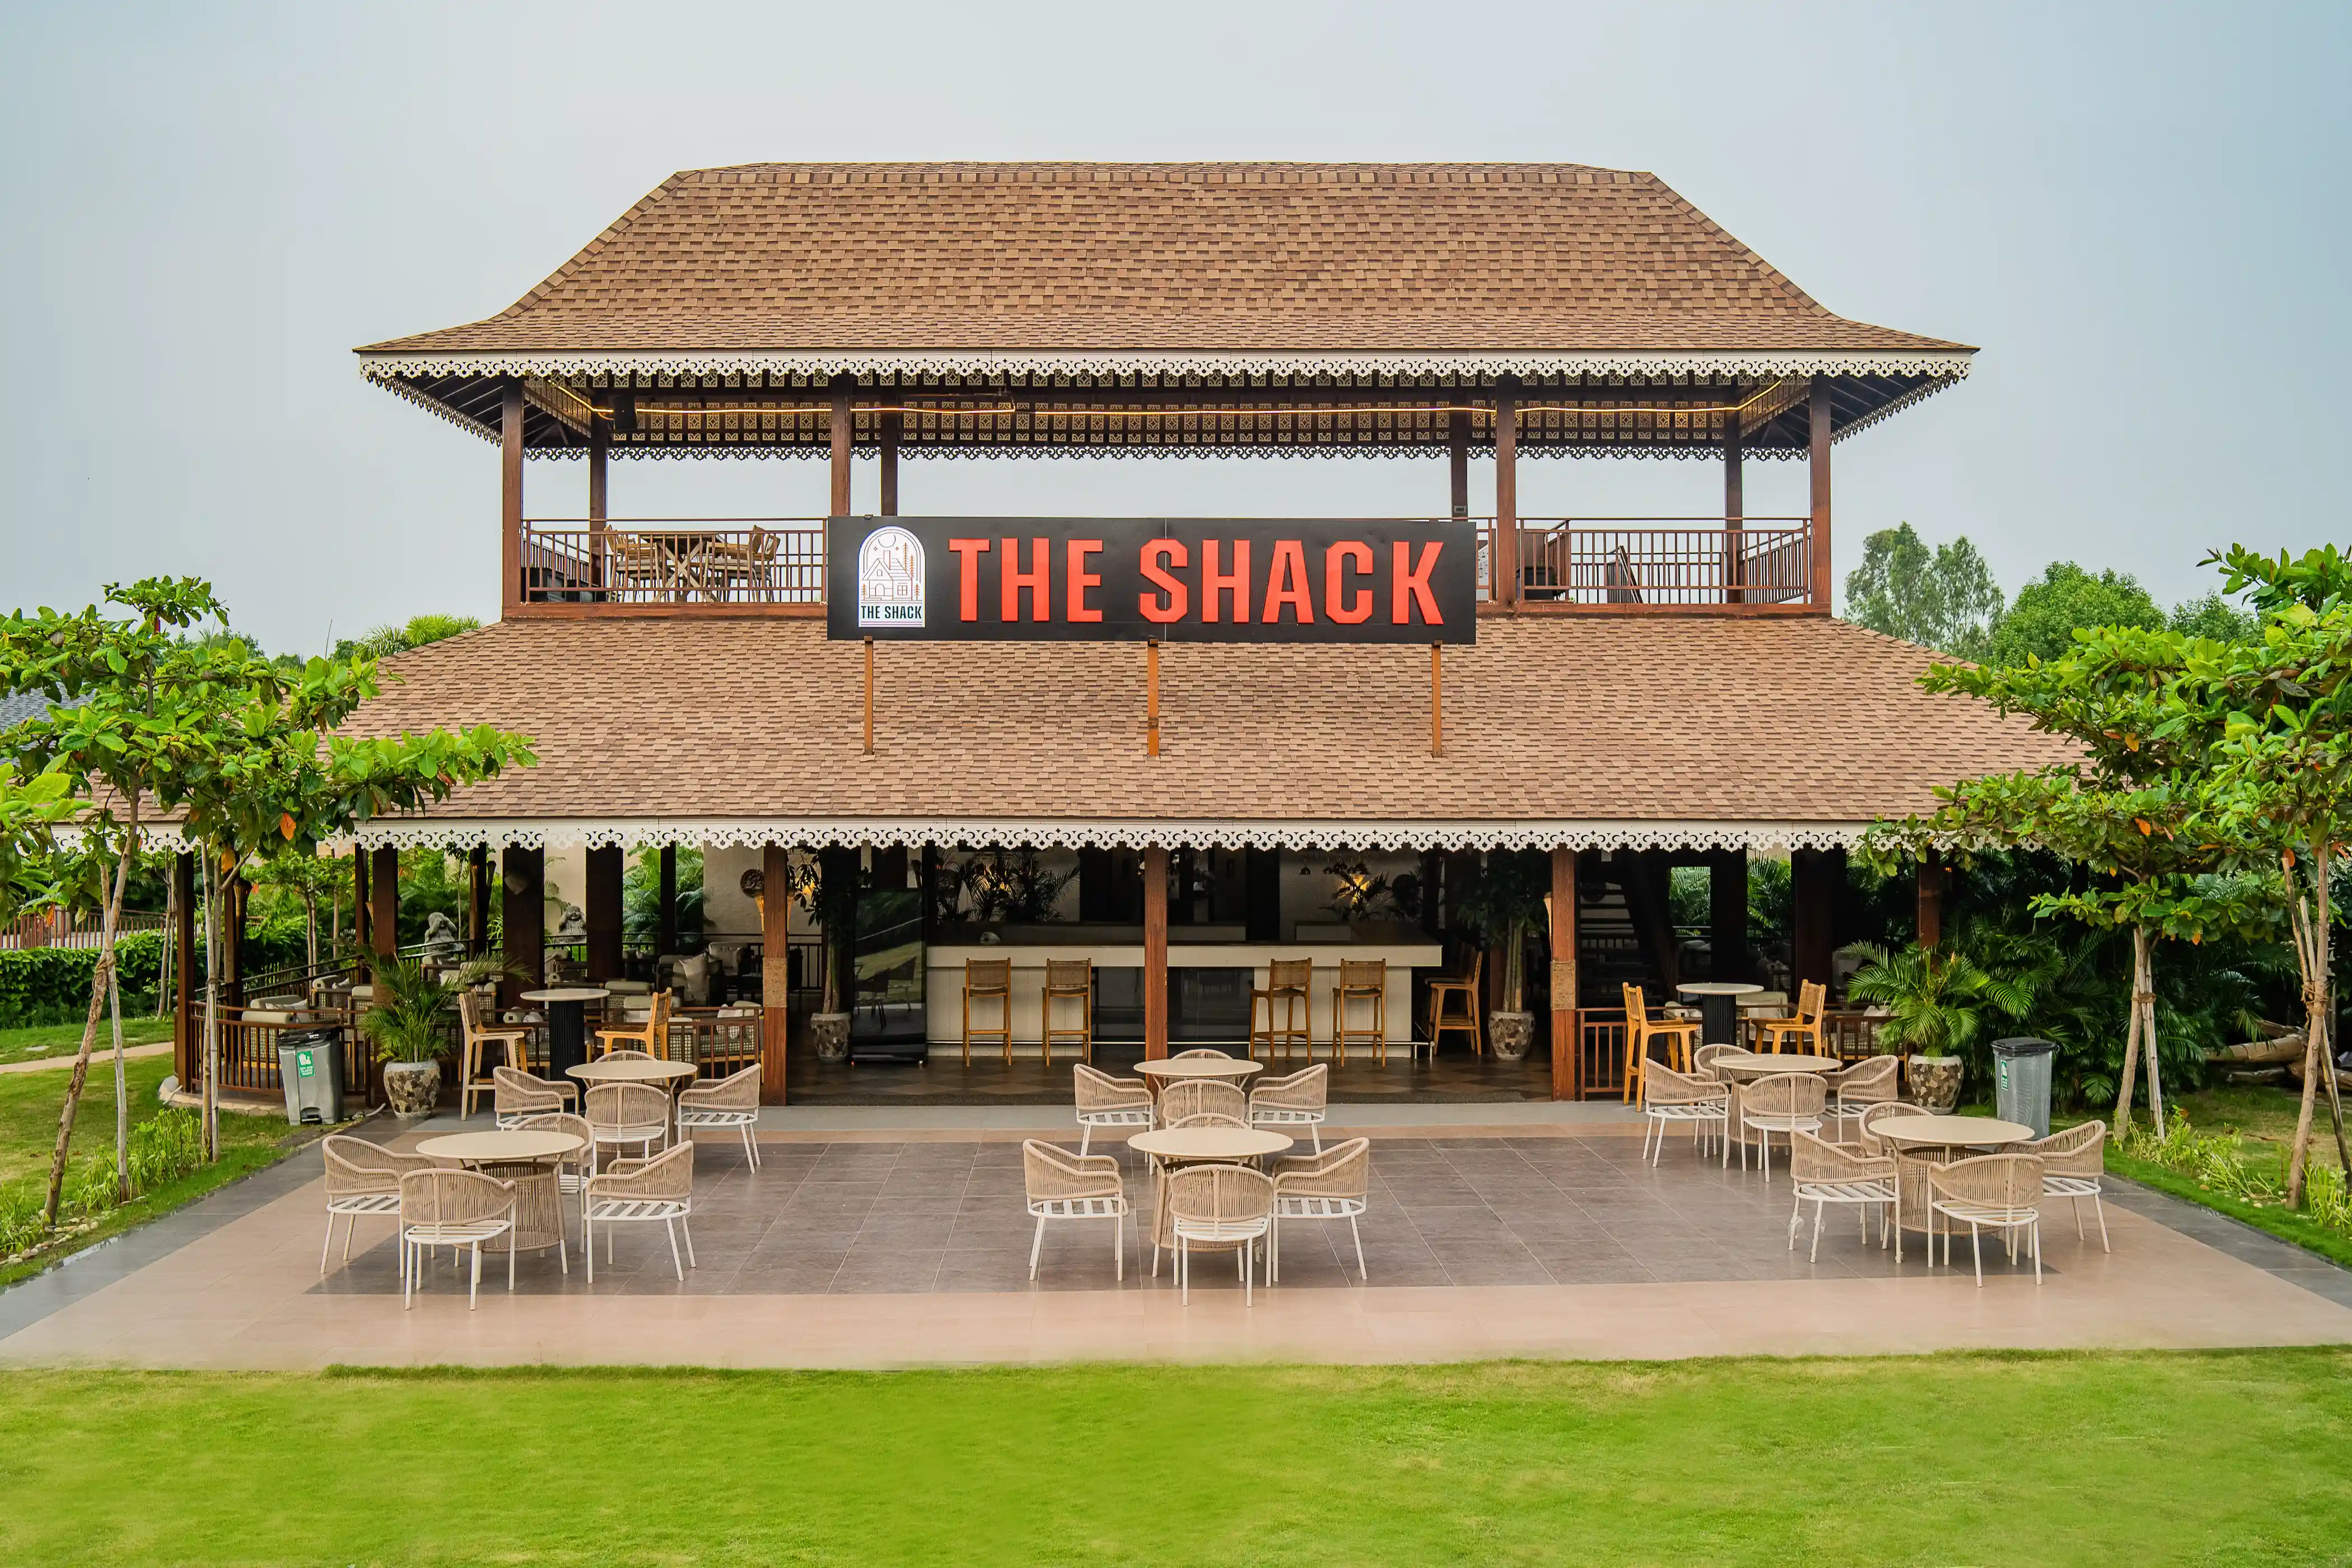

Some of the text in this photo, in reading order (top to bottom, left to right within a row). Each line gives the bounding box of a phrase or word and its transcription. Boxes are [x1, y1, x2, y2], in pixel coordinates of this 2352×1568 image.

[948, 538, 1444, 625] THE SHACK
[861, 605, 922, 619] THE SHACK
